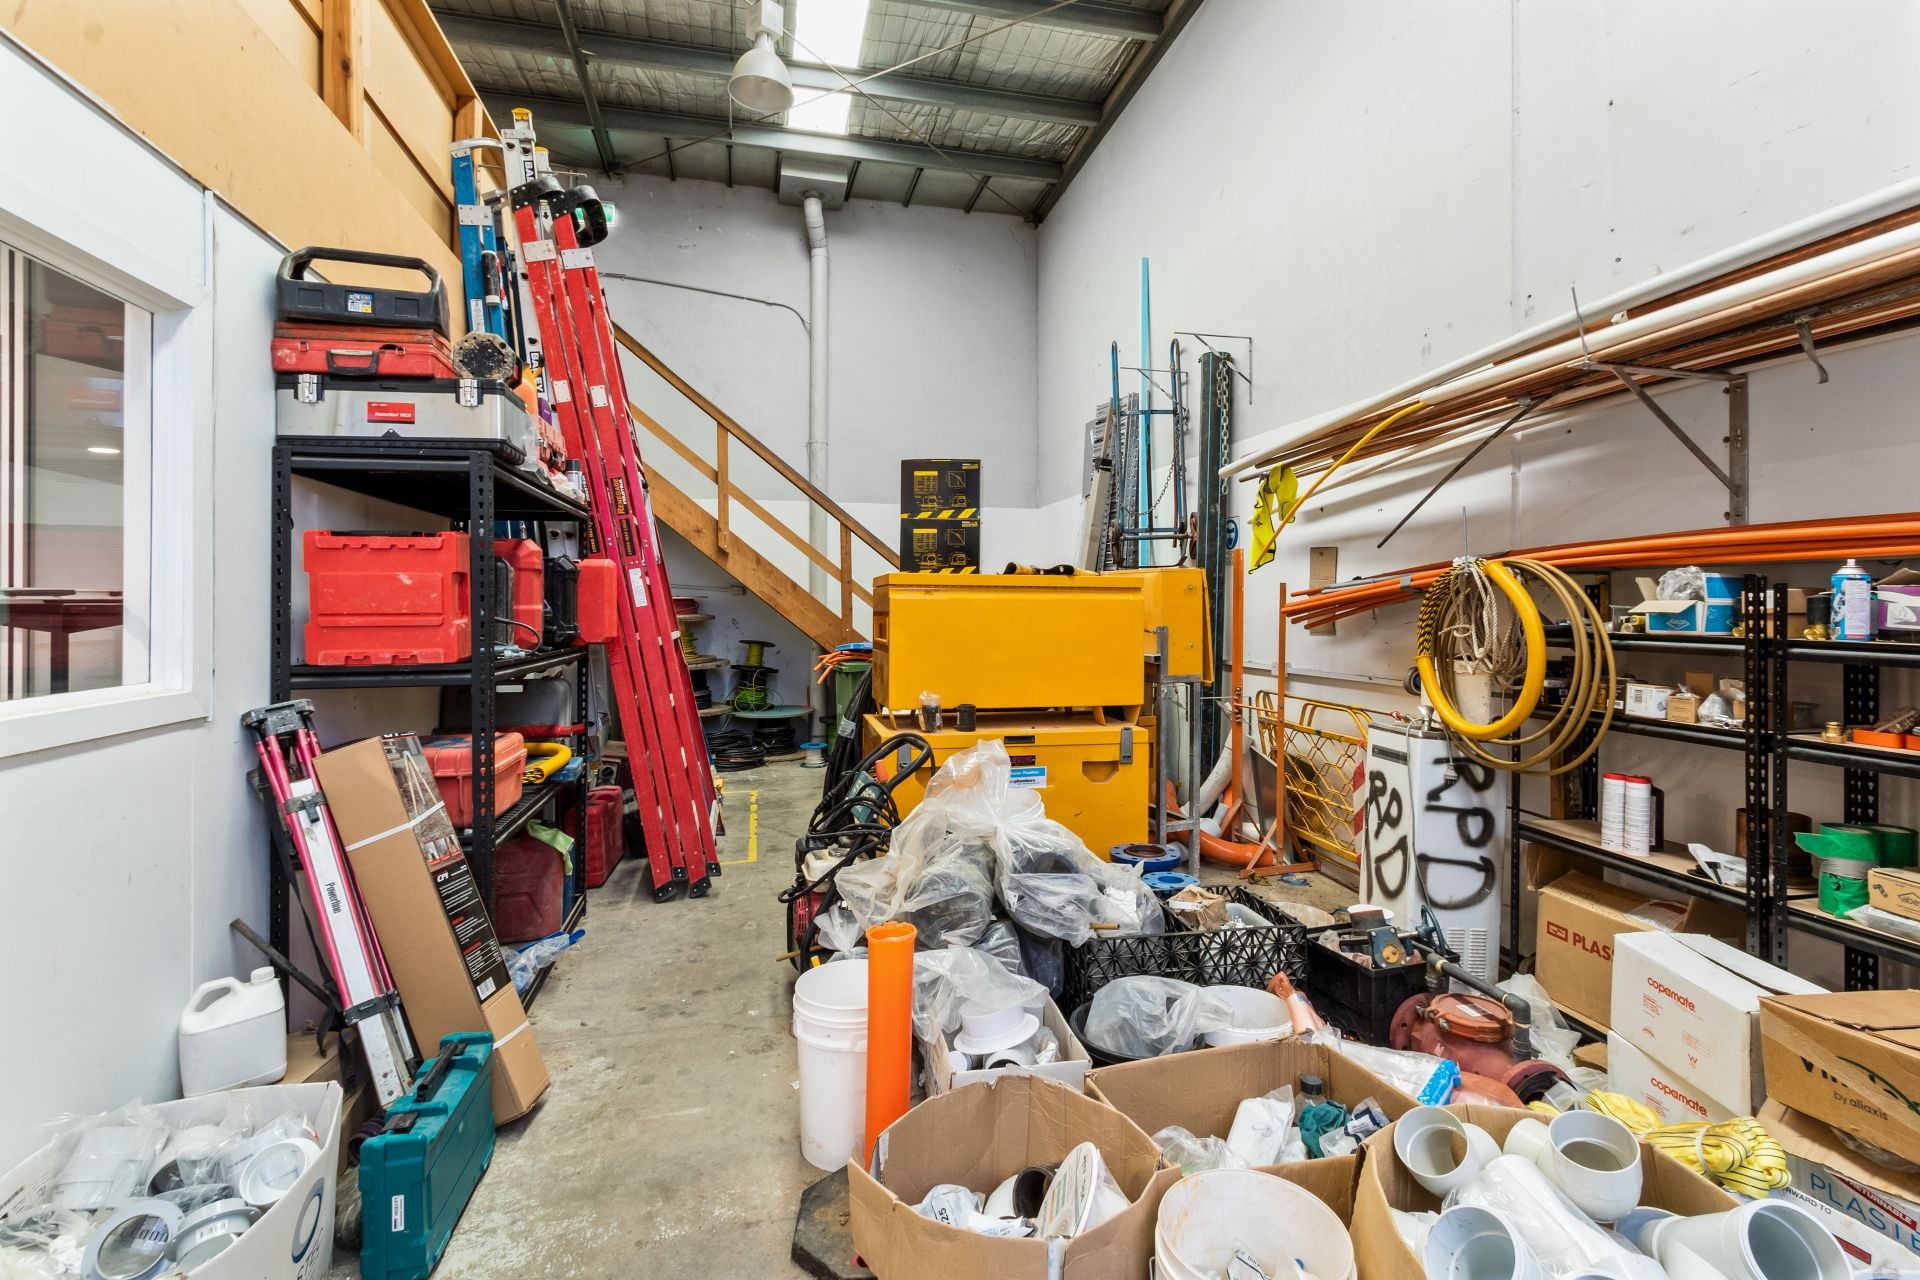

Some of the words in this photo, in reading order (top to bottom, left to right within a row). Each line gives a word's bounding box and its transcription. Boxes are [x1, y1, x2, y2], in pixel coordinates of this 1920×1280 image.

[613, 478, 625, 514] RENEGADE
[1368, 770, 1409, 901] RPD
[1416, 757, 1496, 910] RPD
[1573, 931, 1614, 961] PLAS
[1647, 976, 1696, 1012] copamate
[1650, 1077, 1707, 1117] copamate
[1833, 1089, 1848, 1105] by
[1849, 1098, 1888, 1121] aliaxis
[1819, 1204, 1832, 1215] TO
